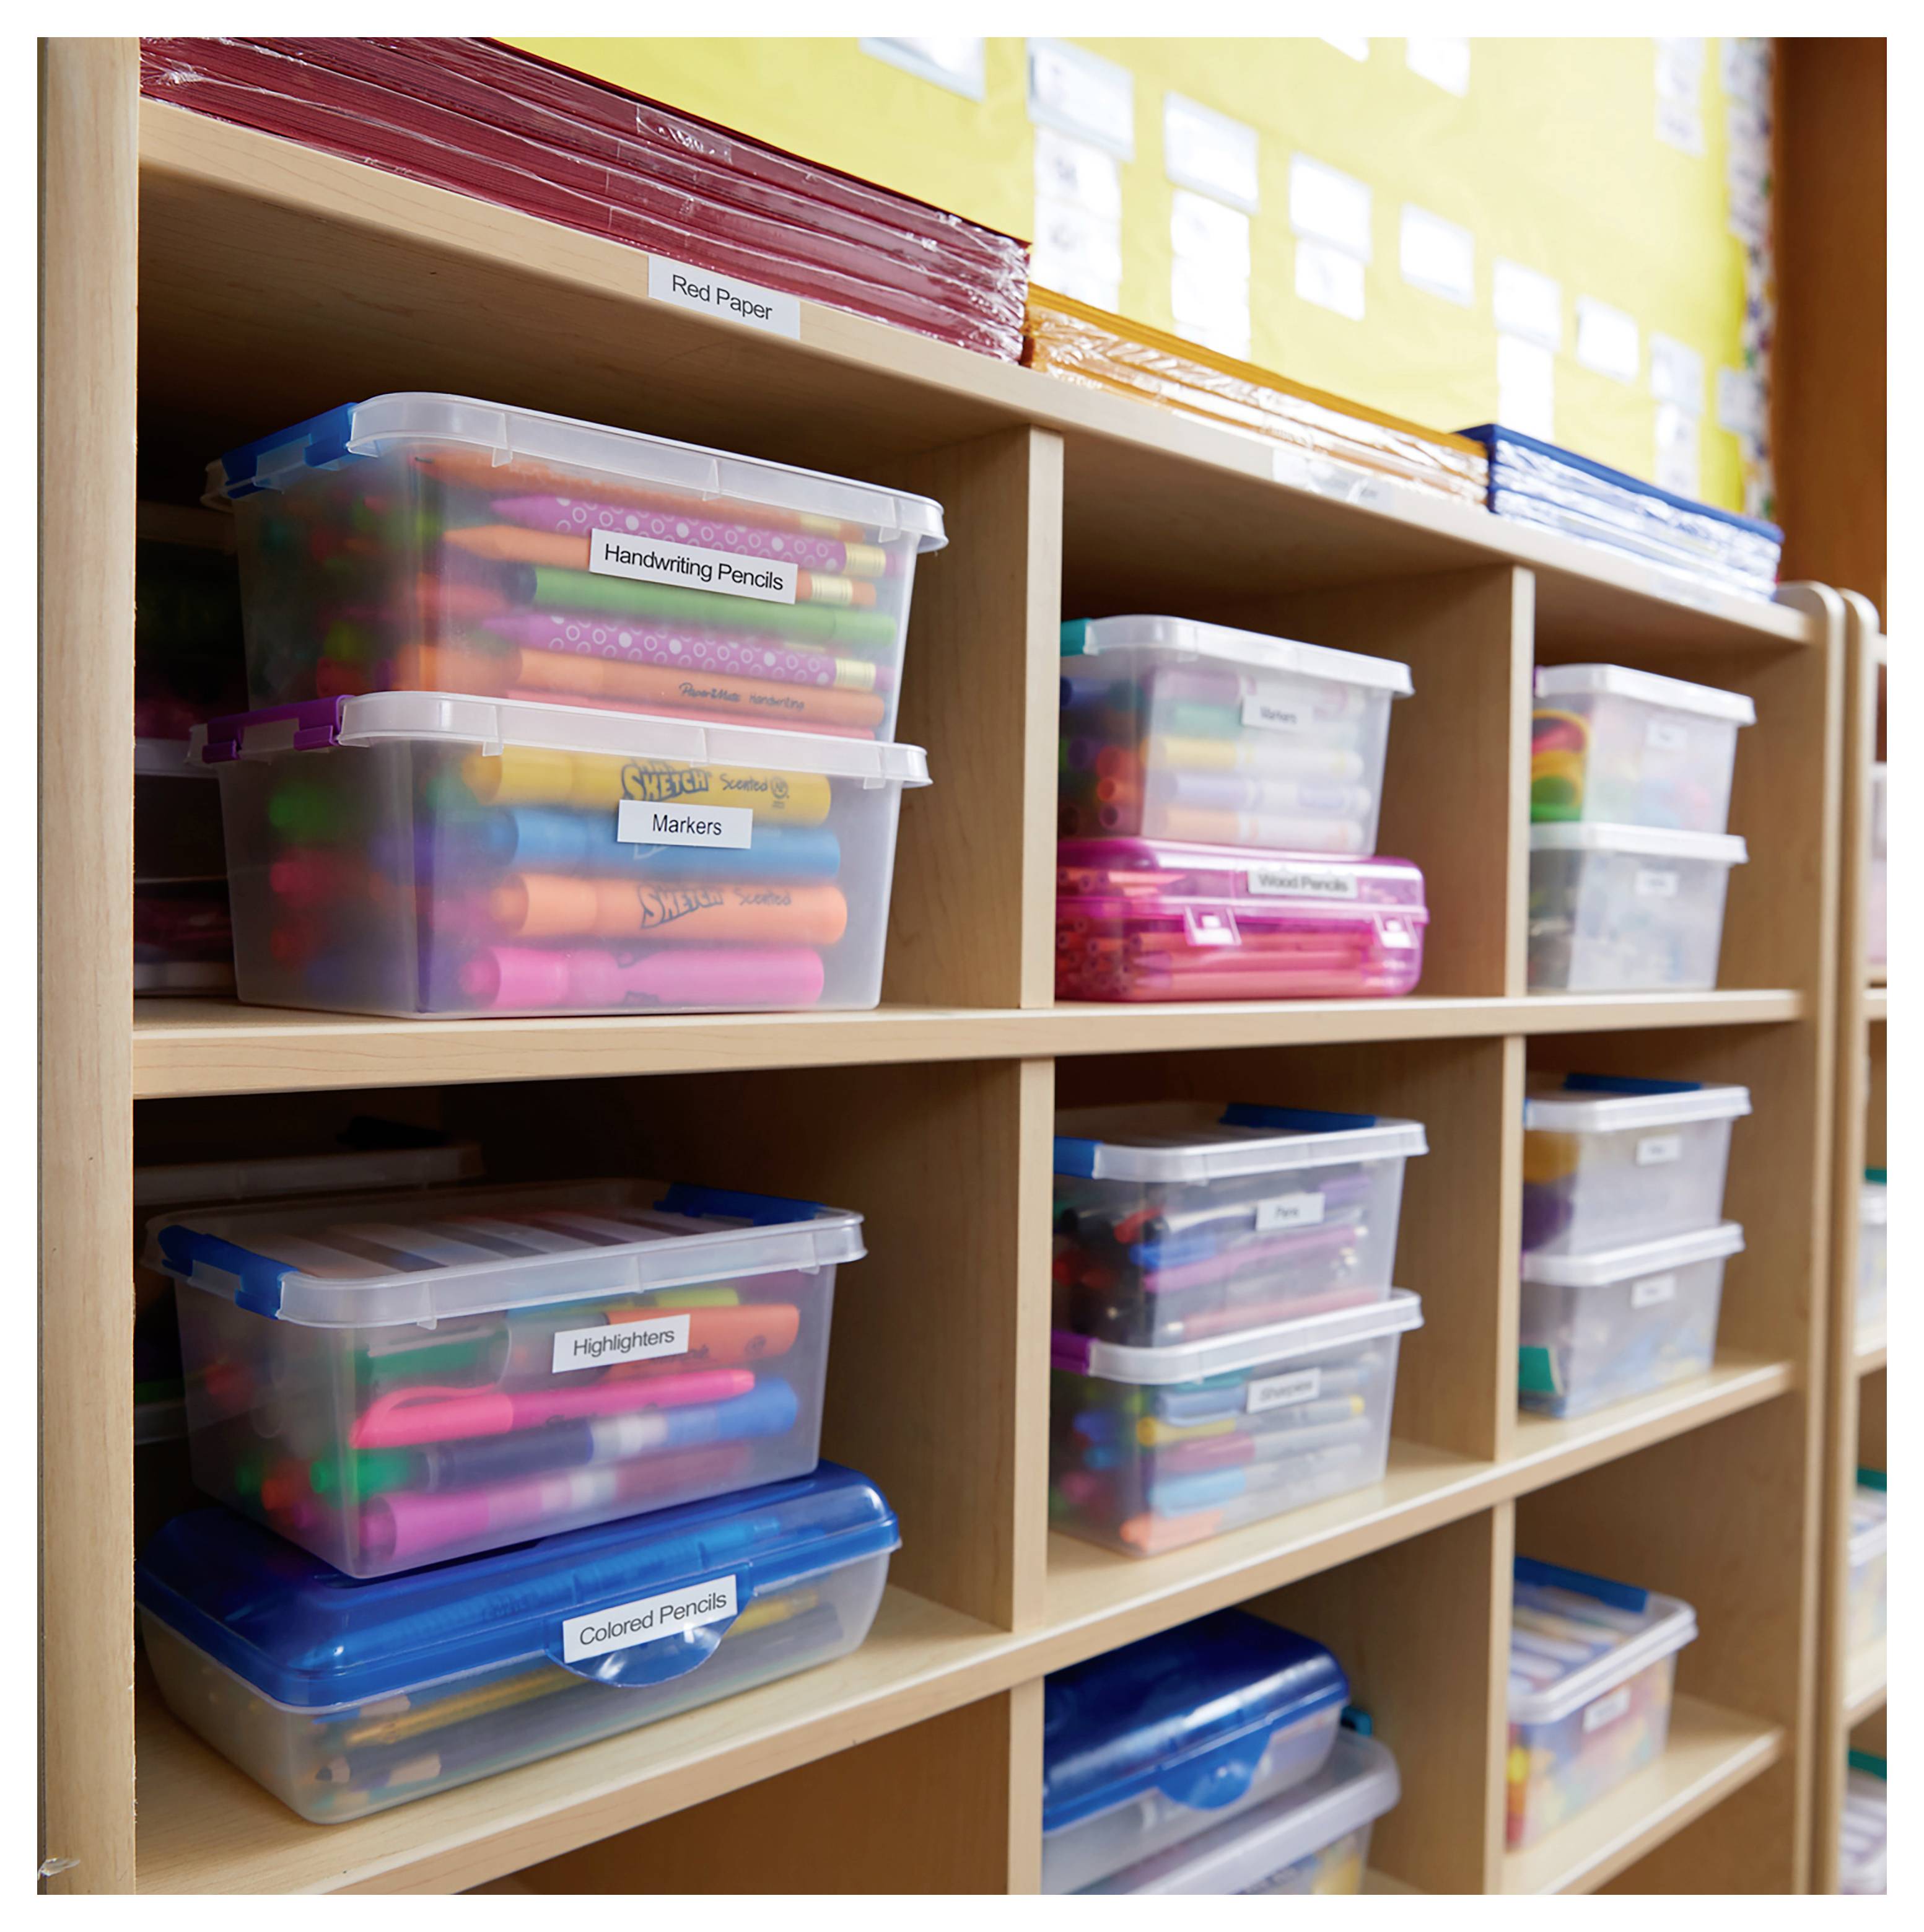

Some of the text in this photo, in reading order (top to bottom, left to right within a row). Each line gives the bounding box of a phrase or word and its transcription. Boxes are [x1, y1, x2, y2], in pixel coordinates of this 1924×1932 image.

[673, 274, 772, 320] Red Paper
[605, 544, 783, 590] Handwriting Pencils
[749, 693, 805, 710] Handwriting
[720, 772, 768, 792] Scented
[653, 814, 722, 836] Markers
[1258, 872, 1349, 892] Wood Pencils
[574, 1331, 675, 1357] Highlighters
[580, 1593, 727, 1645] Colored Pencils
